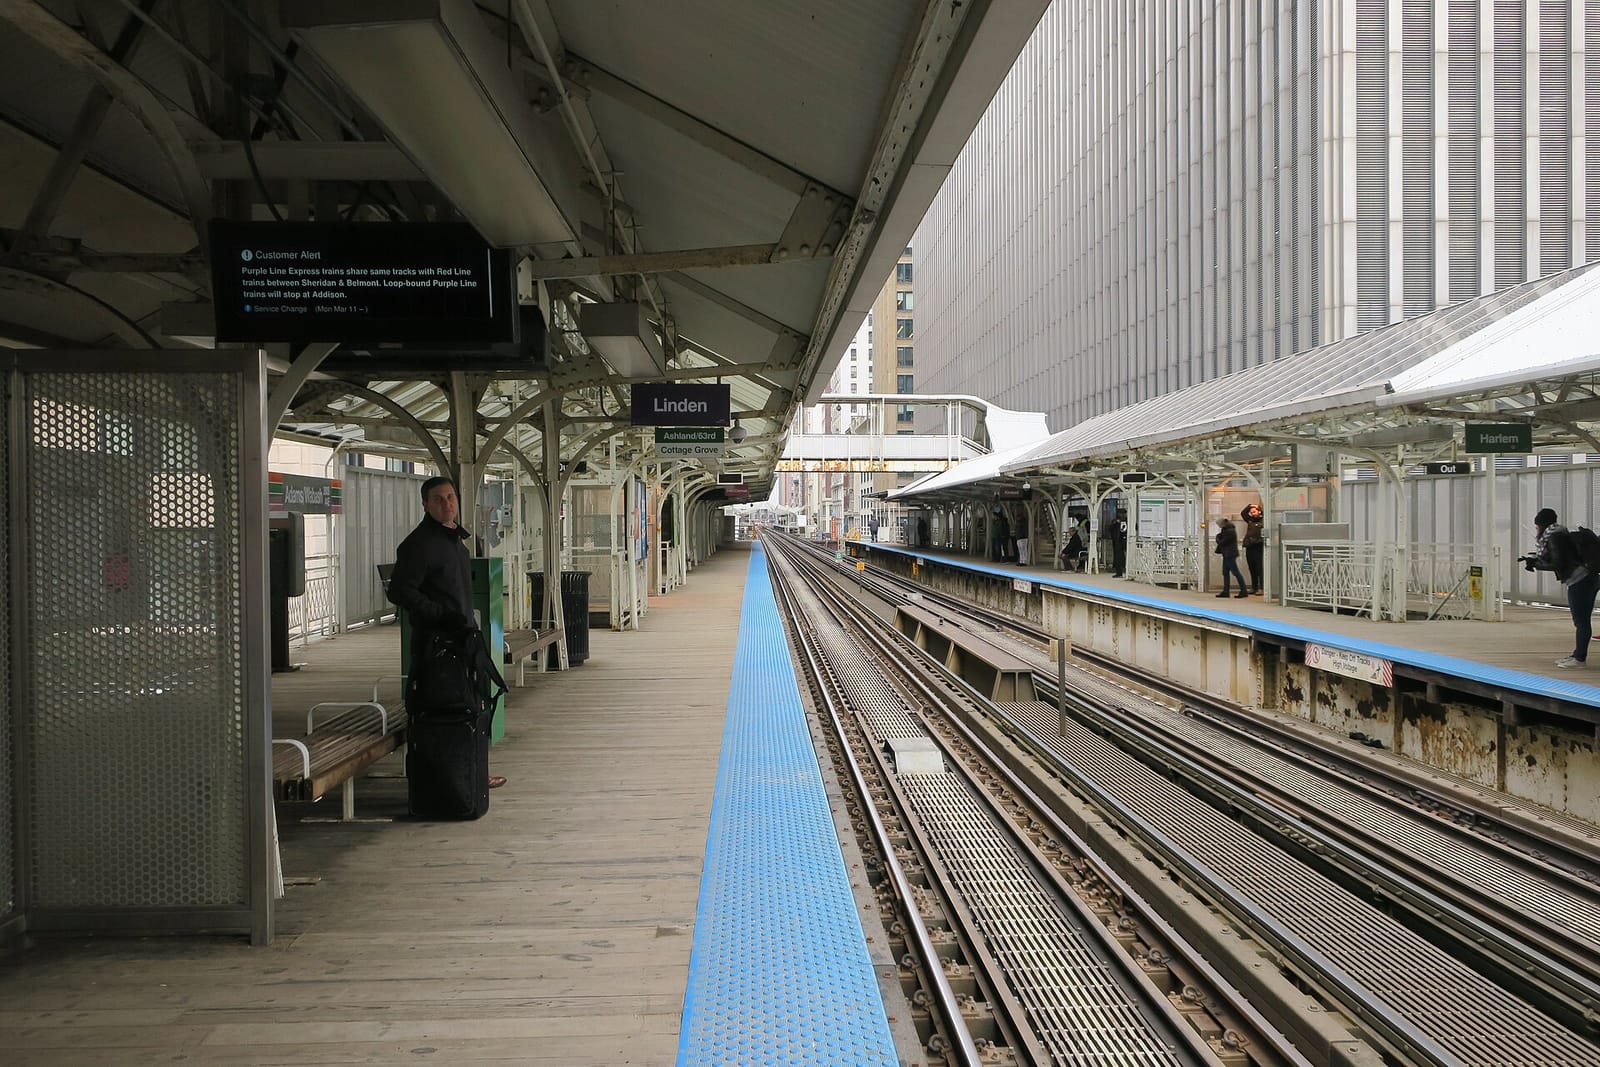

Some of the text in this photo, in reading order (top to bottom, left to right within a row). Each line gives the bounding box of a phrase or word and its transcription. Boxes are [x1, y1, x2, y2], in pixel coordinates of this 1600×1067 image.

[255, 250, 321, 260] Customer Alert
[241, 266, 471, 276] Purple Line Express trains share same tracks with Red Line
[242, 278, 477, 288] trains between Sheridan & Belmont. Loop-bound Purple Line
[243, 290, 348, 300] trains will stop at Addison.
[254, 305, 279, 313] Service
[280, 305, 308, 313] Change
[314, 305, 333, 313] (Mon
[334, 305, 347, 313] Mar
[349, 305, 357, 313] 11
[653, 397, 708, 413] Linden
[663, 431, 717, 441] Ashland/63rd
[1479, 432, 1520, 444] Harlem
[660, 446, 719, 456] Cottage Grove
[1440, 464, 1457, 474] Out
[1321, 647, 1336, 659] Danger
